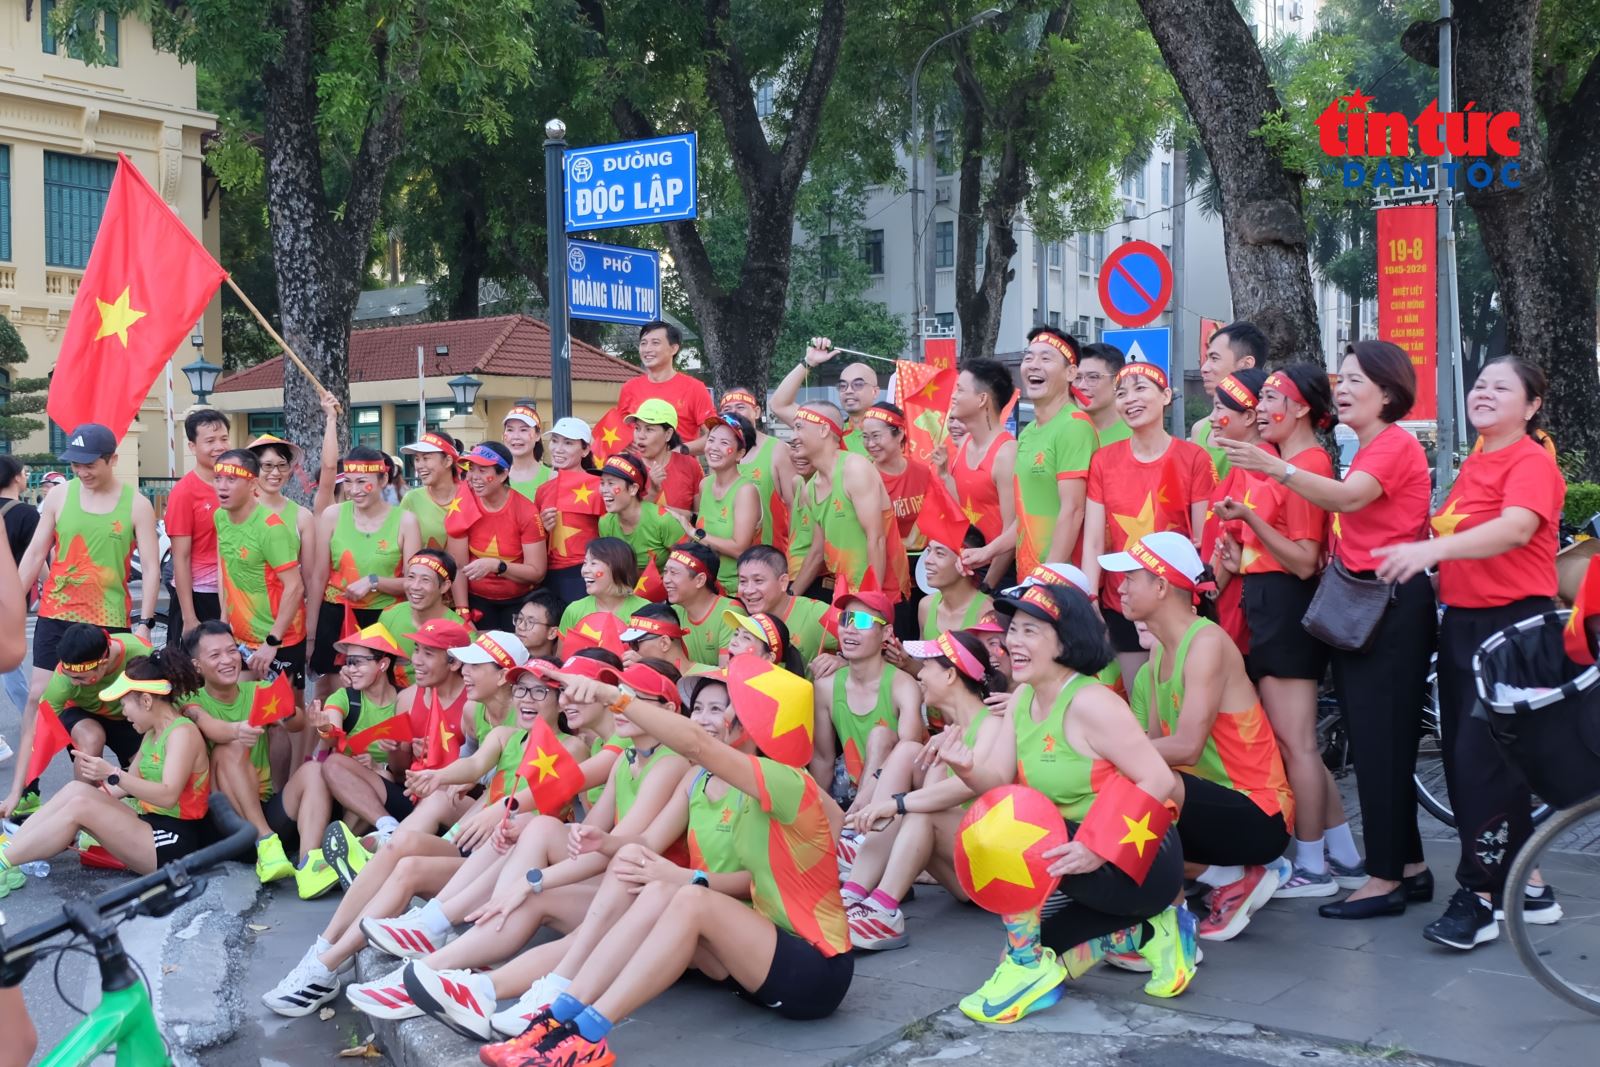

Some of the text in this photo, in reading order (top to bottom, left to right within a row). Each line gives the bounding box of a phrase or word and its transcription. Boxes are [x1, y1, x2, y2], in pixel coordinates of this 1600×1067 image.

[603, 150, 673, 172] ĐƯỜNG
[576, 174, 683, 219] ĐỘC LẬP
[1389, 238, 1422, 261] 19-8
[603, 255, 632, 273] PHỐ
[572, 274, 654, 318] HOÀNG VĂN THỤ
[1410, 354, 1424, 365] ÔNG
